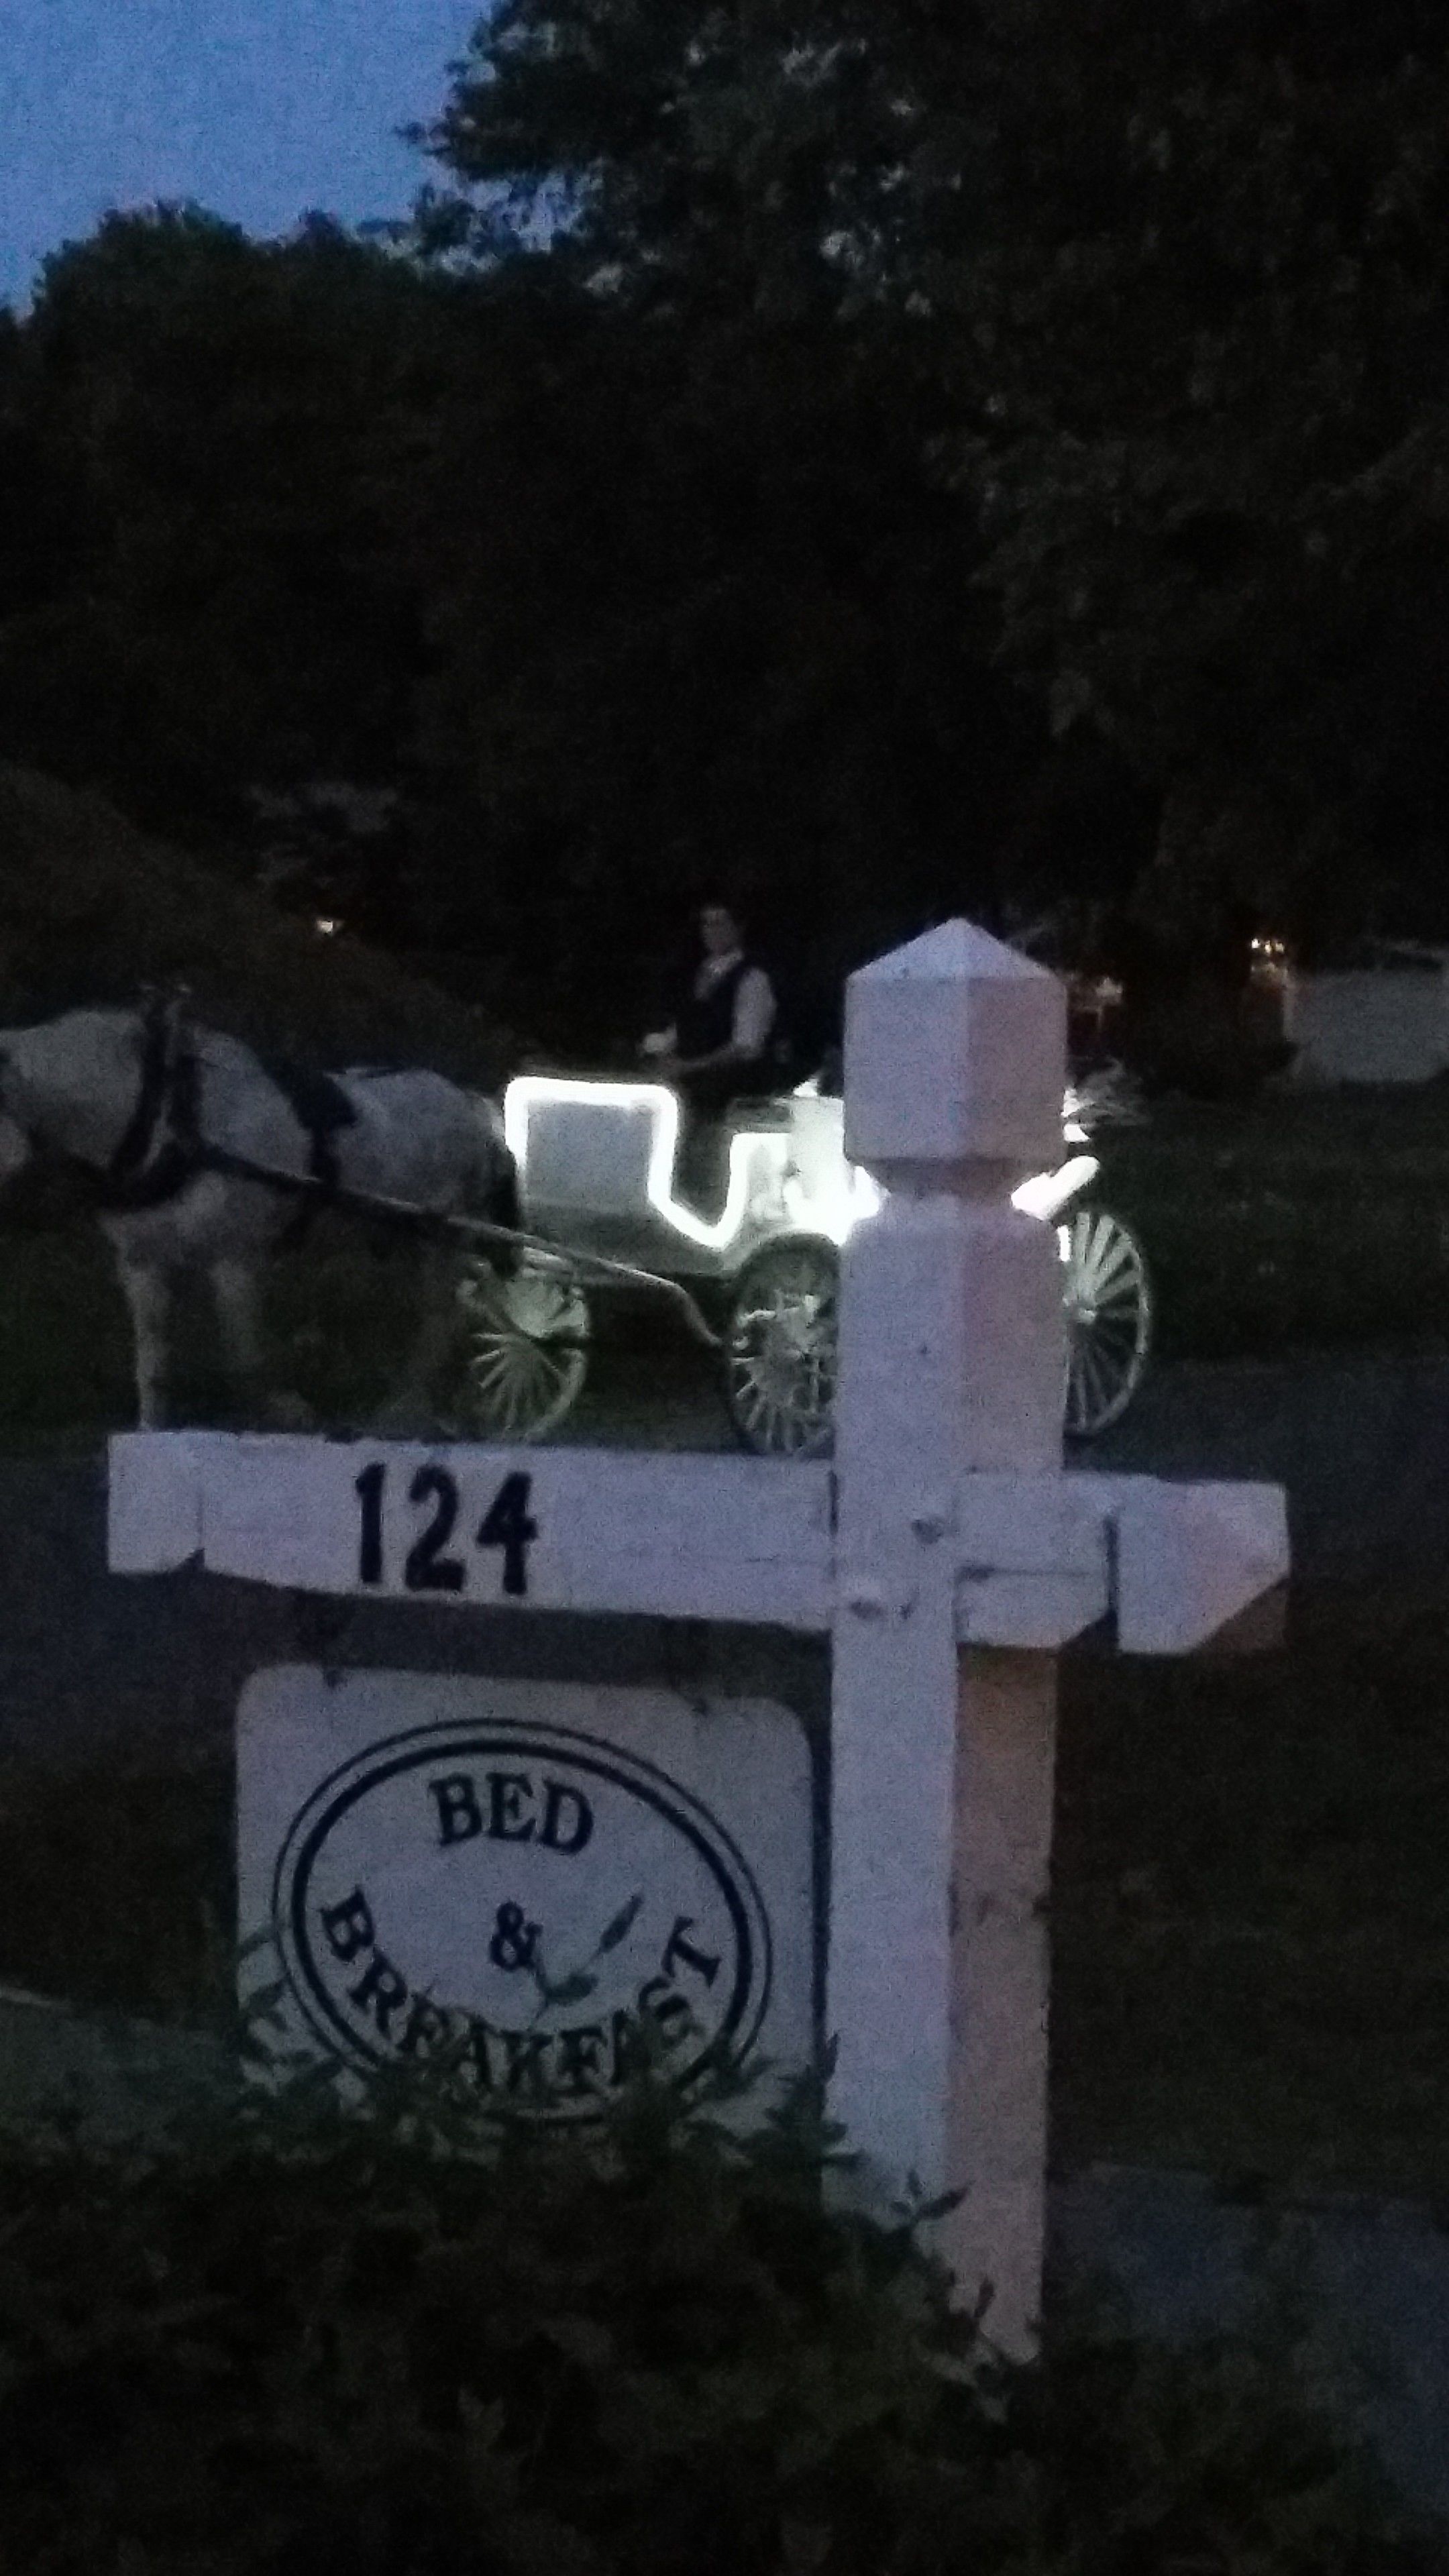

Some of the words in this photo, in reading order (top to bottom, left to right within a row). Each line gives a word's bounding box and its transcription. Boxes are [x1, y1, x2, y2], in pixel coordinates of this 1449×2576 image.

[355, 1460, 539, 1595] 124
[428, 1772, 593, 1855] BED
[490, 1900, 542, 1972] &
